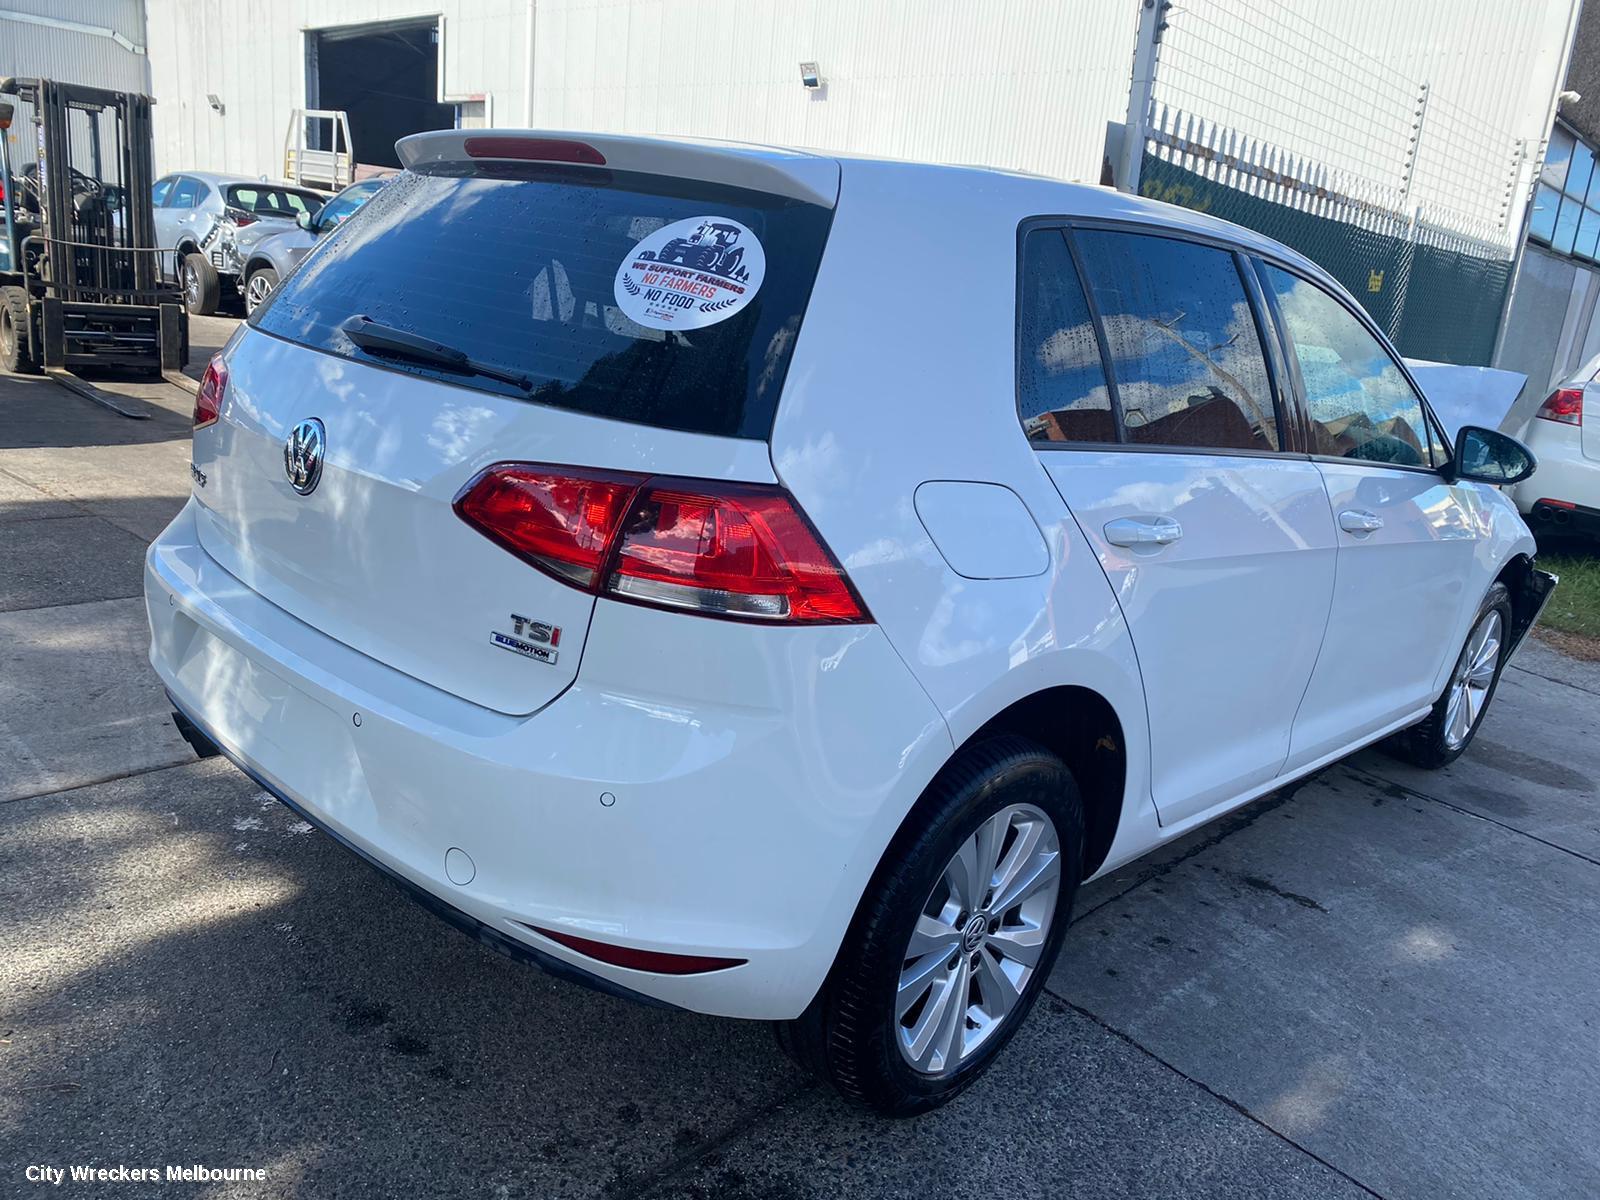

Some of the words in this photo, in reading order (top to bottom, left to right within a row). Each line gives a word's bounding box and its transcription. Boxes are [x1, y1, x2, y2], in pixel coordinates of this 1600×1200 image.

[632, 262, 646, 270] WE
[647, 263, 695, 278] SUPPORT
[695, 273, 746, 295] FARMERS
[641, 272, 659, 284] NO
[659, 276, 717, 299] FARMERS
[643, 288, 662, 301] NO
[661, 292, 695, 309] FOOD
[510, 614, 561, 647] TSI
